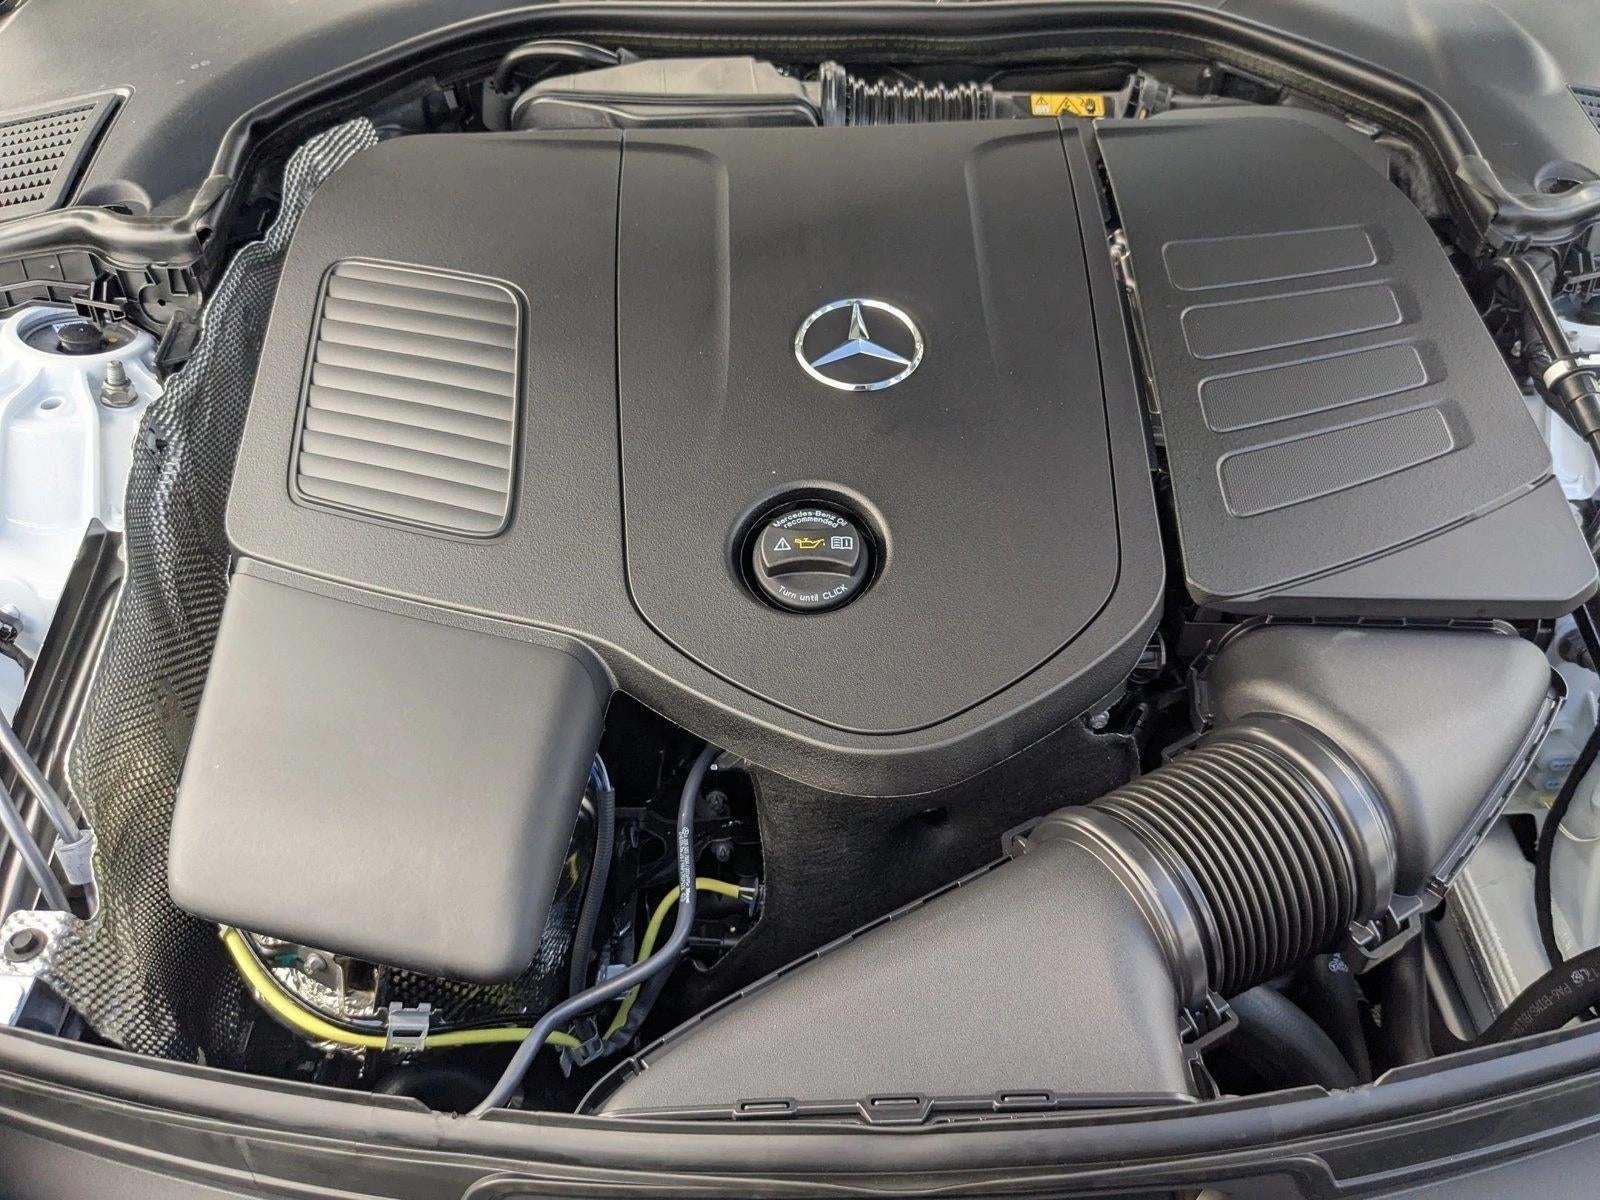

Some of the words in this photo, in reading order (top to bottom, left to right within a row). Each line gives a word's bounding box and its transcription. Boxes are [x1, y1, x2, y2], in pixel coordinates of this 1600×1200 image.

[772, 510, 836, 528] Mercedes-Benz
[836, 517, 848, 527] Oil
[783, 516, 839, 529] recommended
[778, 585, 797, 599] Turn
[799, 593, 819, 602] until
[822, 583, 848, 600] CLICK
